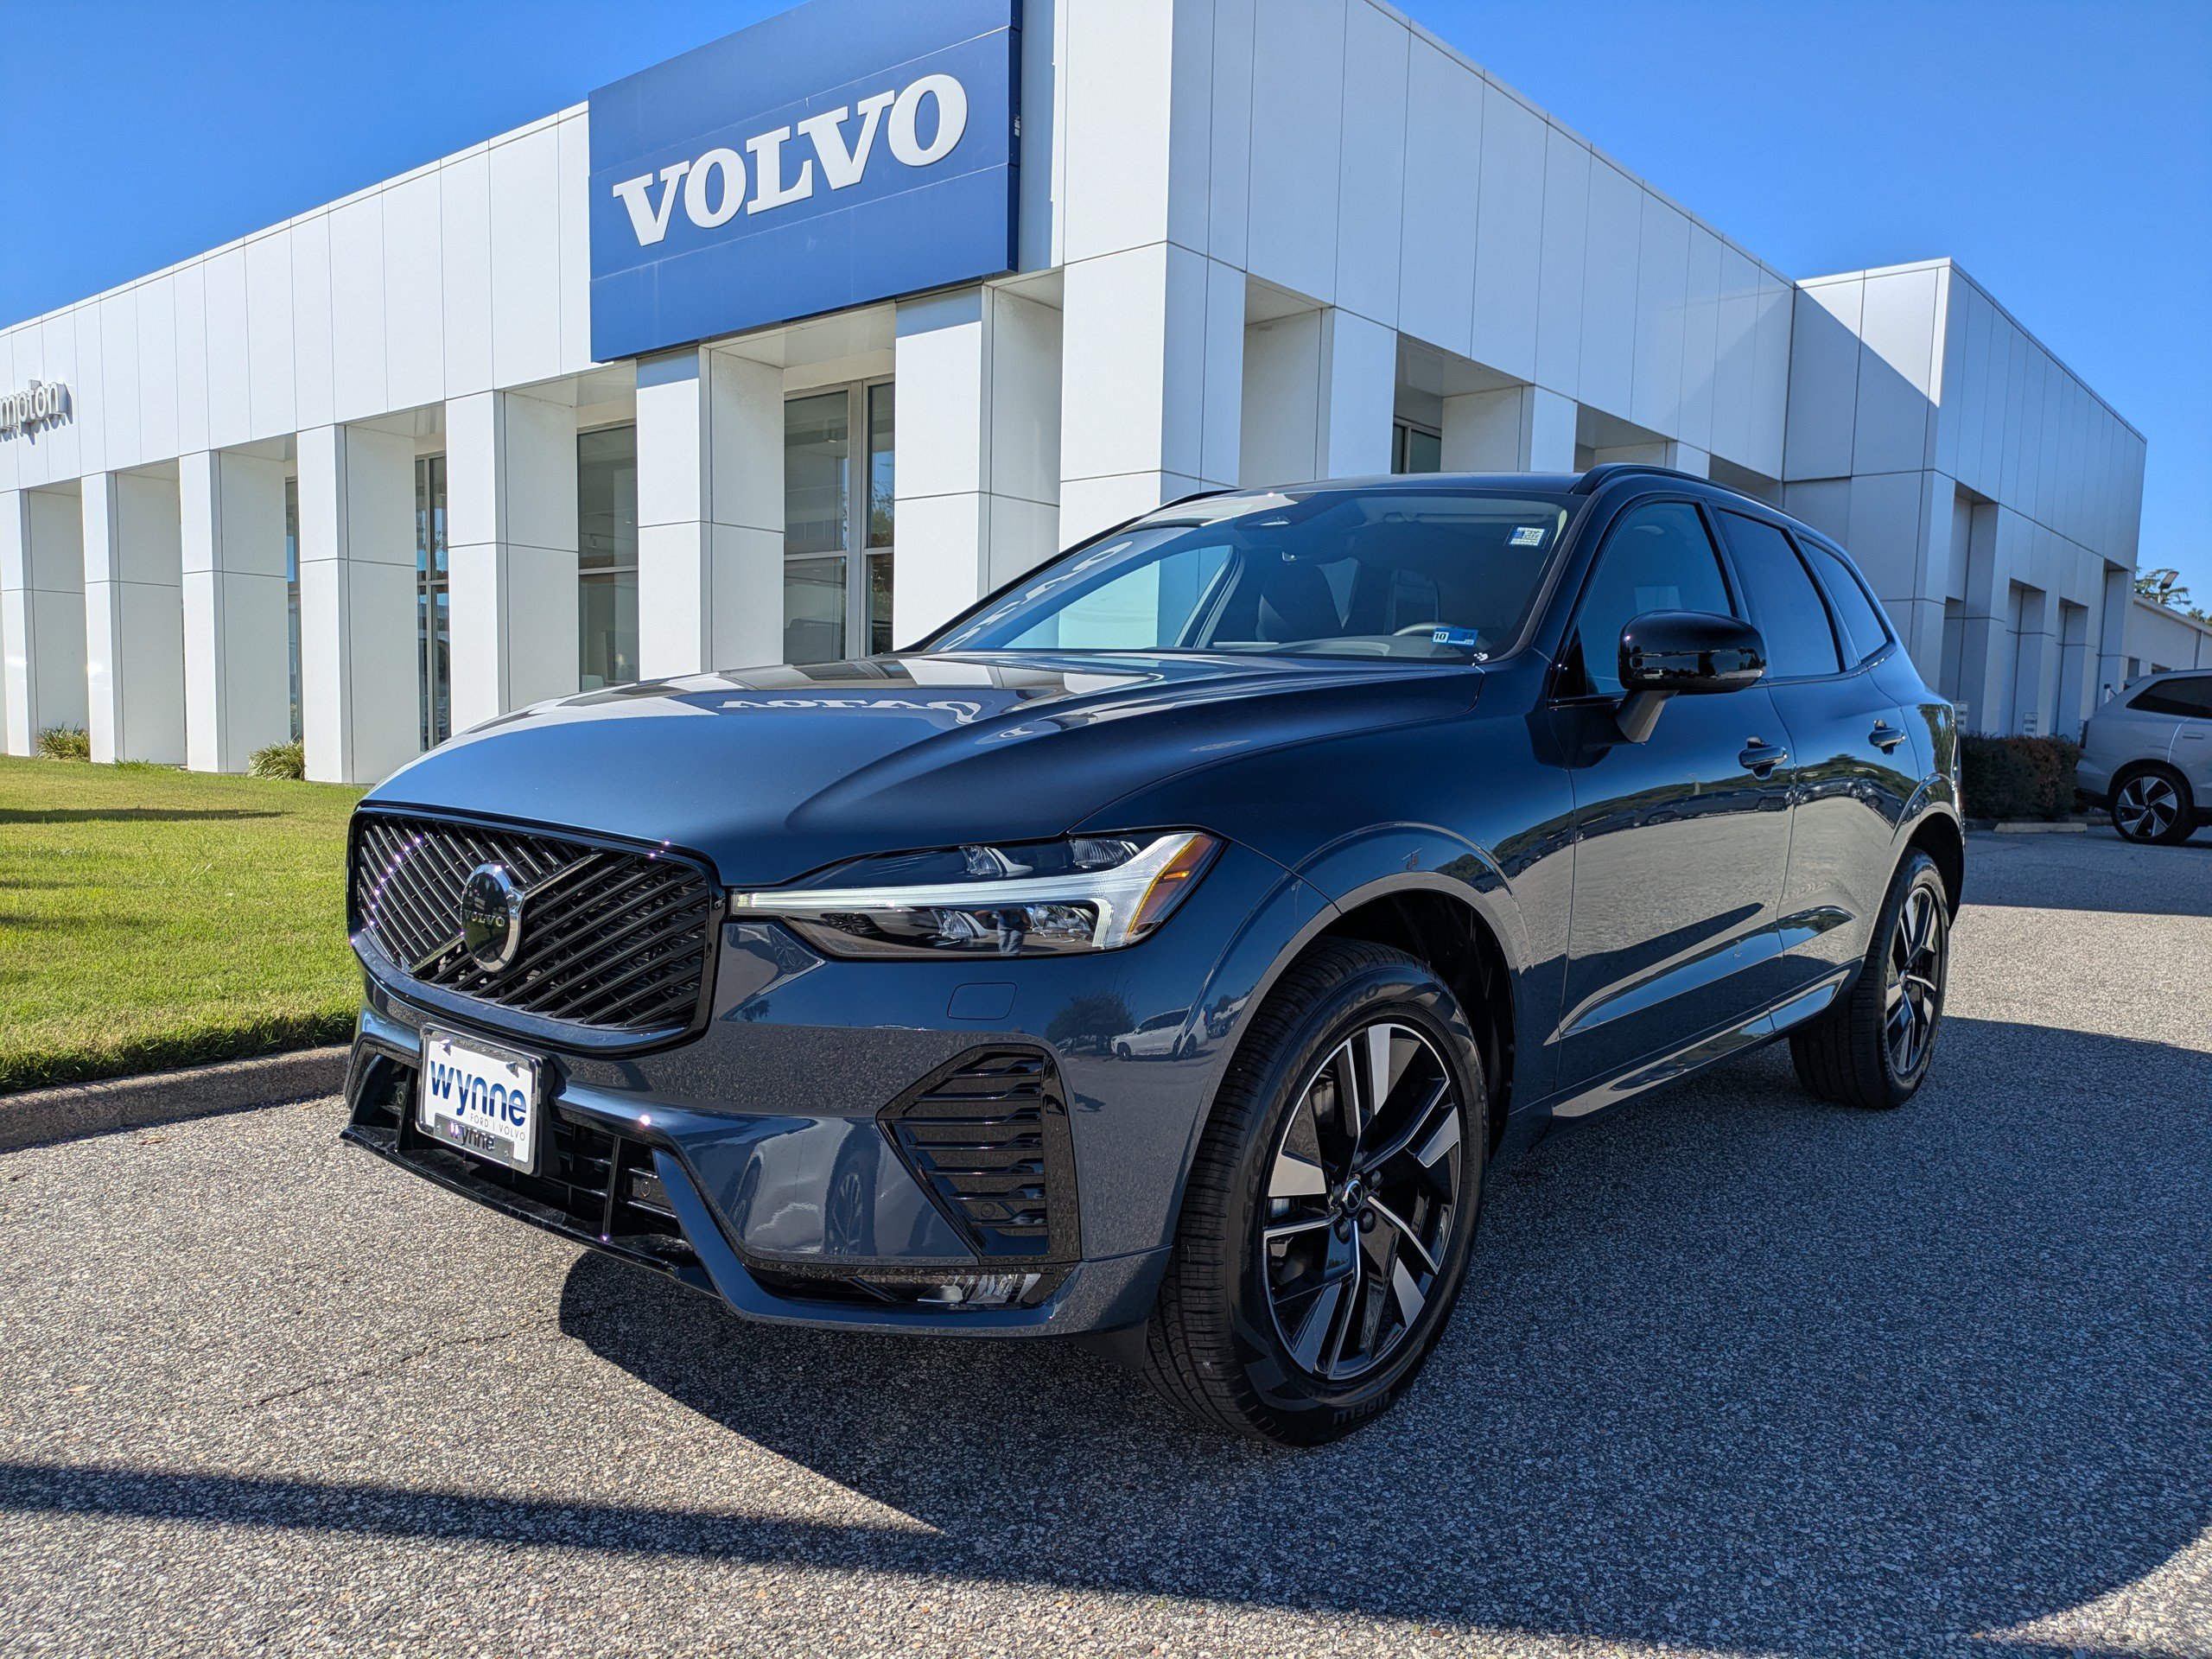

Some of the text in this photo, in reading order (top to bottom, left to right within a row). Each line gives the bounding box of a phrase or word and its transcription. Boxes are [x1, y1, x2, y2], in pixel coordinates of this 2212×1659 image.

[613, 73, 969, 246] VOLVO
[1434, 632, 1447, 641] 10
[464, 909, 506, 928] VOLVO
[430, 1060, 527, 1127] wynne
[470, 1113, 526, 1141] FORD VOLVO
